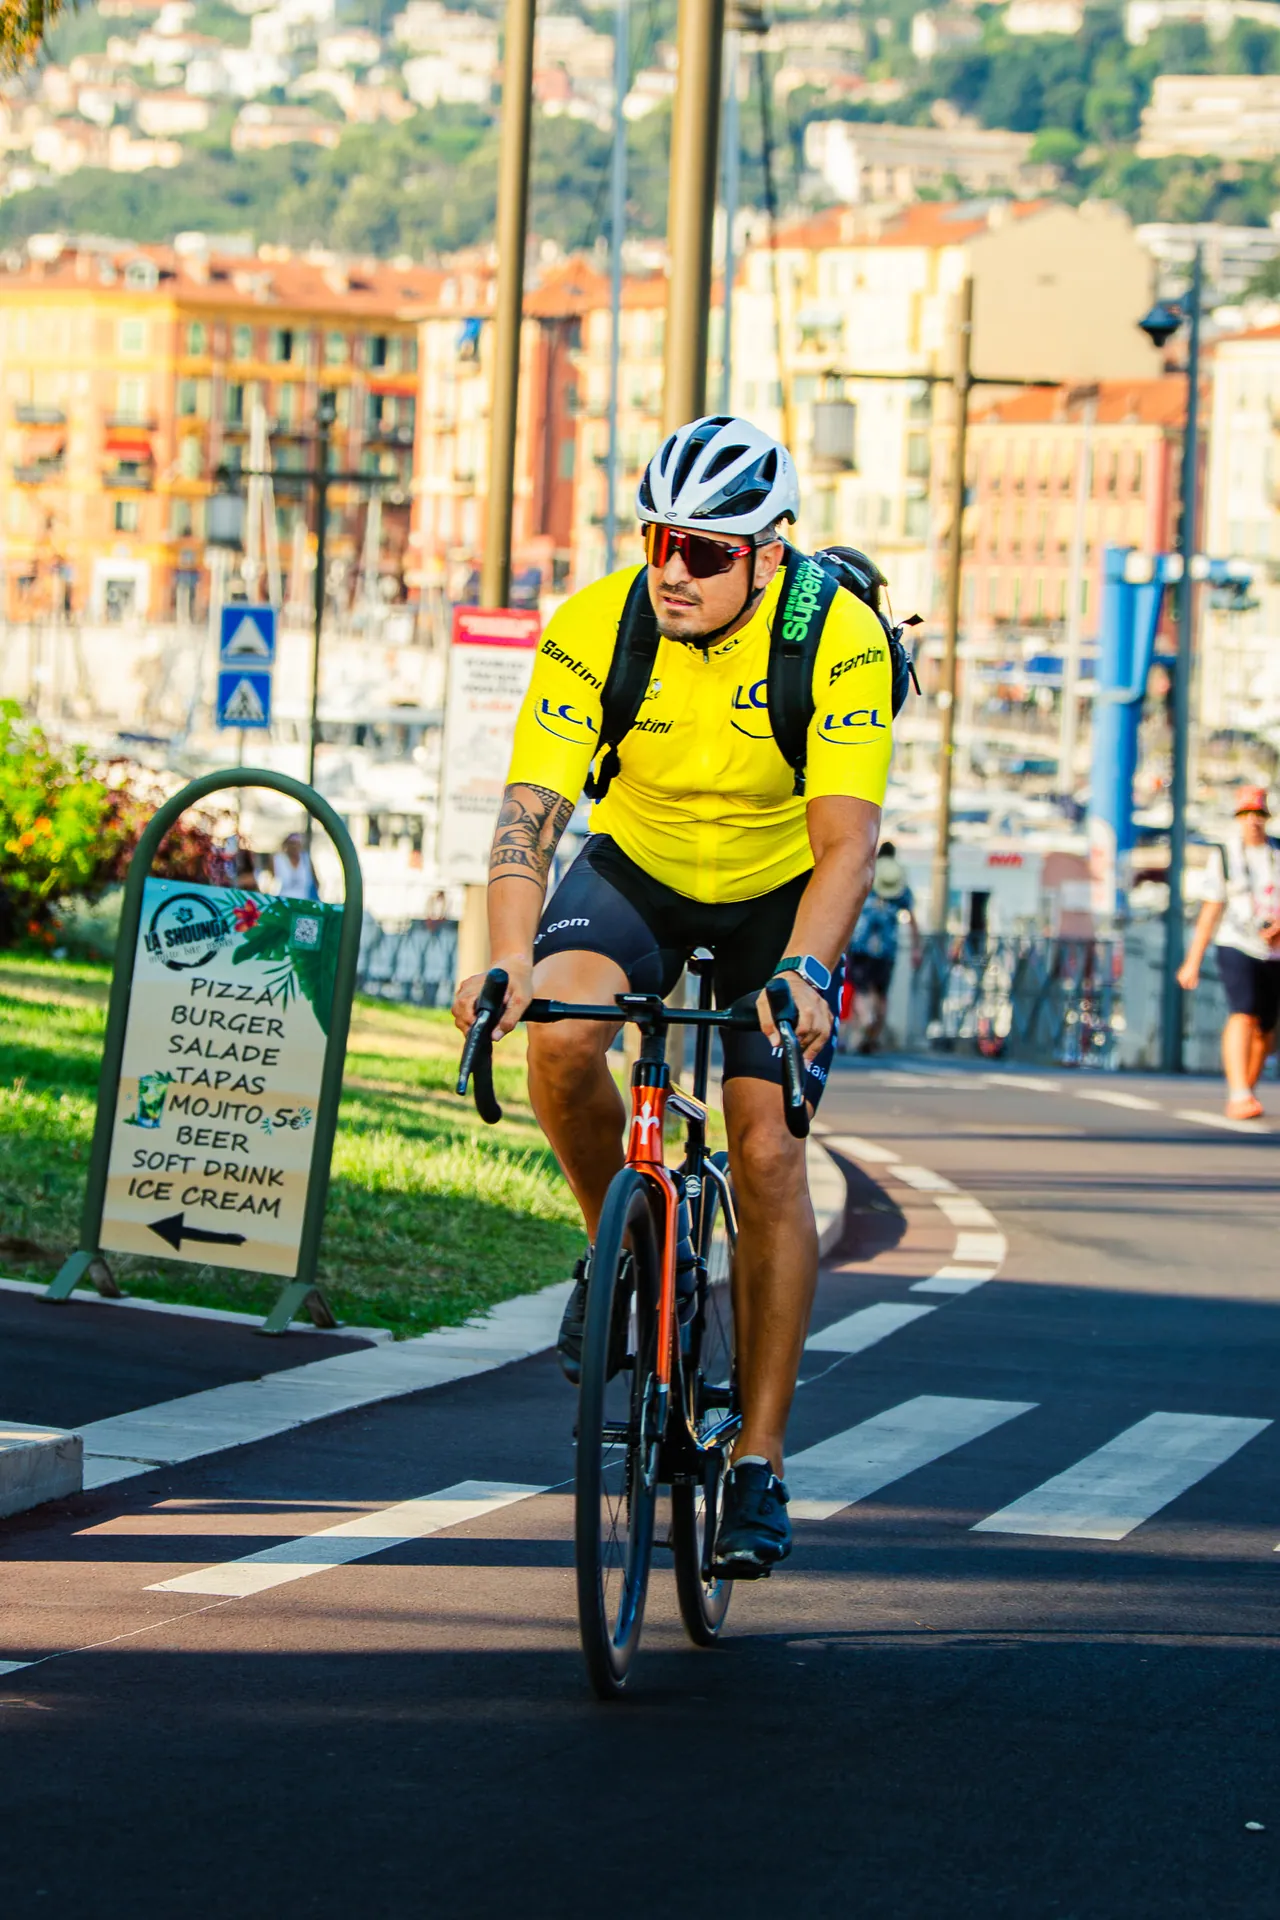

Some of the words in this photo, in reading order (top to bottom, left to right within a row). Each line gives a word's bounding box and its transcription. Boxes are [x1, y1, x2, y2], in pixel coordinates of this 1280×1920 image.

[541, 639, 602, 690] Santini
[735, 678, 768, 709] LC
[541, 698, 599, 734] LCL
[823, 709, 886, 730] LCL
[143, 931, 163, 953] LA
[190, 977, 274, 1007] PIZZA
[171, 1005, 285, 1039] BURGER
[168, 1034, 281, 1066] SALADE
[176, 1066, 266, 1095] TAPAS
[168, 1095, 263, 1125] MOJITO
[272, 1108, 302, 1130] 5€
[176, 1125, 249, 1154] BEER
[132, 1149, 196, 1174] SOFT
[203, 1159, 284, 1187] DRINK
[128, 1177, 173, 1201] ICE
[181, 1186, 281, 1218] CREAM
